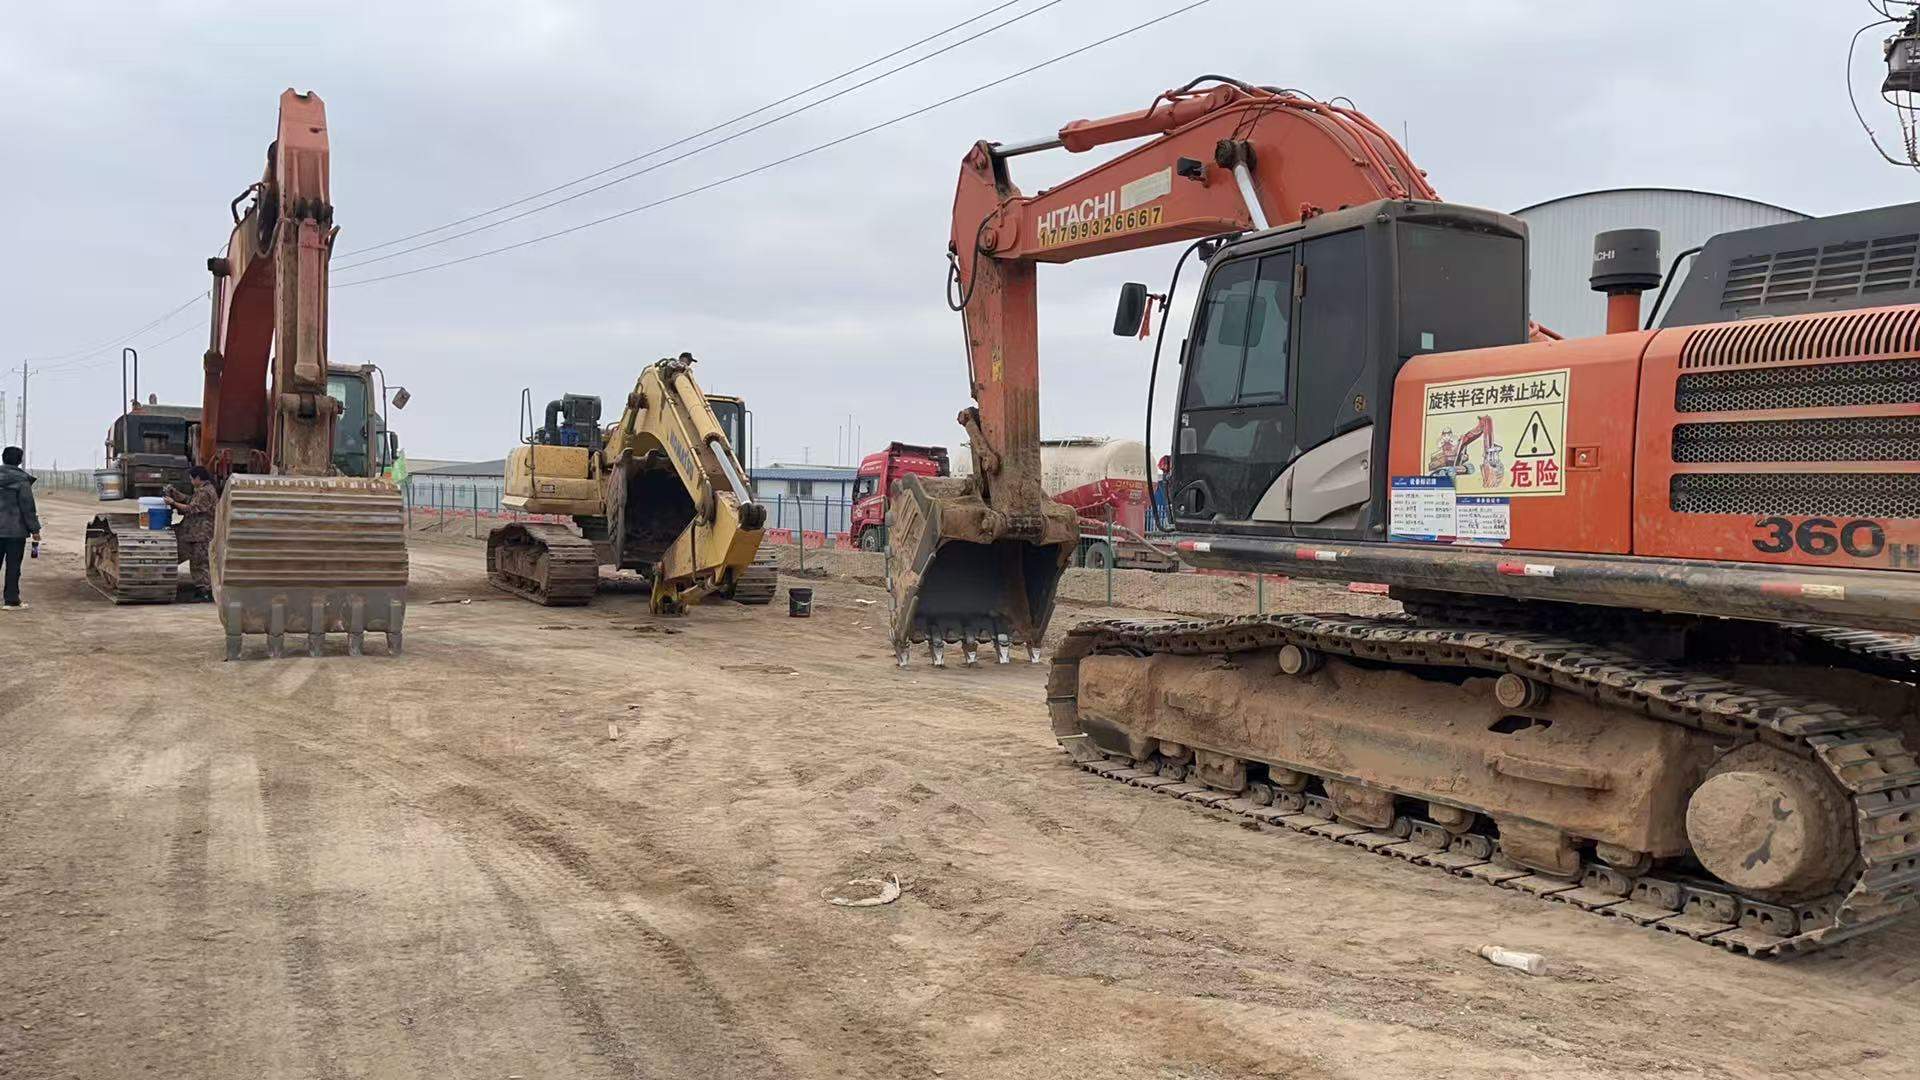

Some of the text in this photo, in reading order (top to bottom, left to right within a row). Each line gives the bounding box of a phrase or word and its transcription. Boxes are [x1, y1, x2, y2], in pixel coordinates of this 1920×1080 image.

[1037, 190, 1116, 239] HITACHI
[1040, 207, 1161, 246] 17799326667
[1429, 379, 1561, 410] 旋转半径内禁止站人
[1510, 459, 1559, 487] 危险
[1752, 516, 1886, 558] 360
